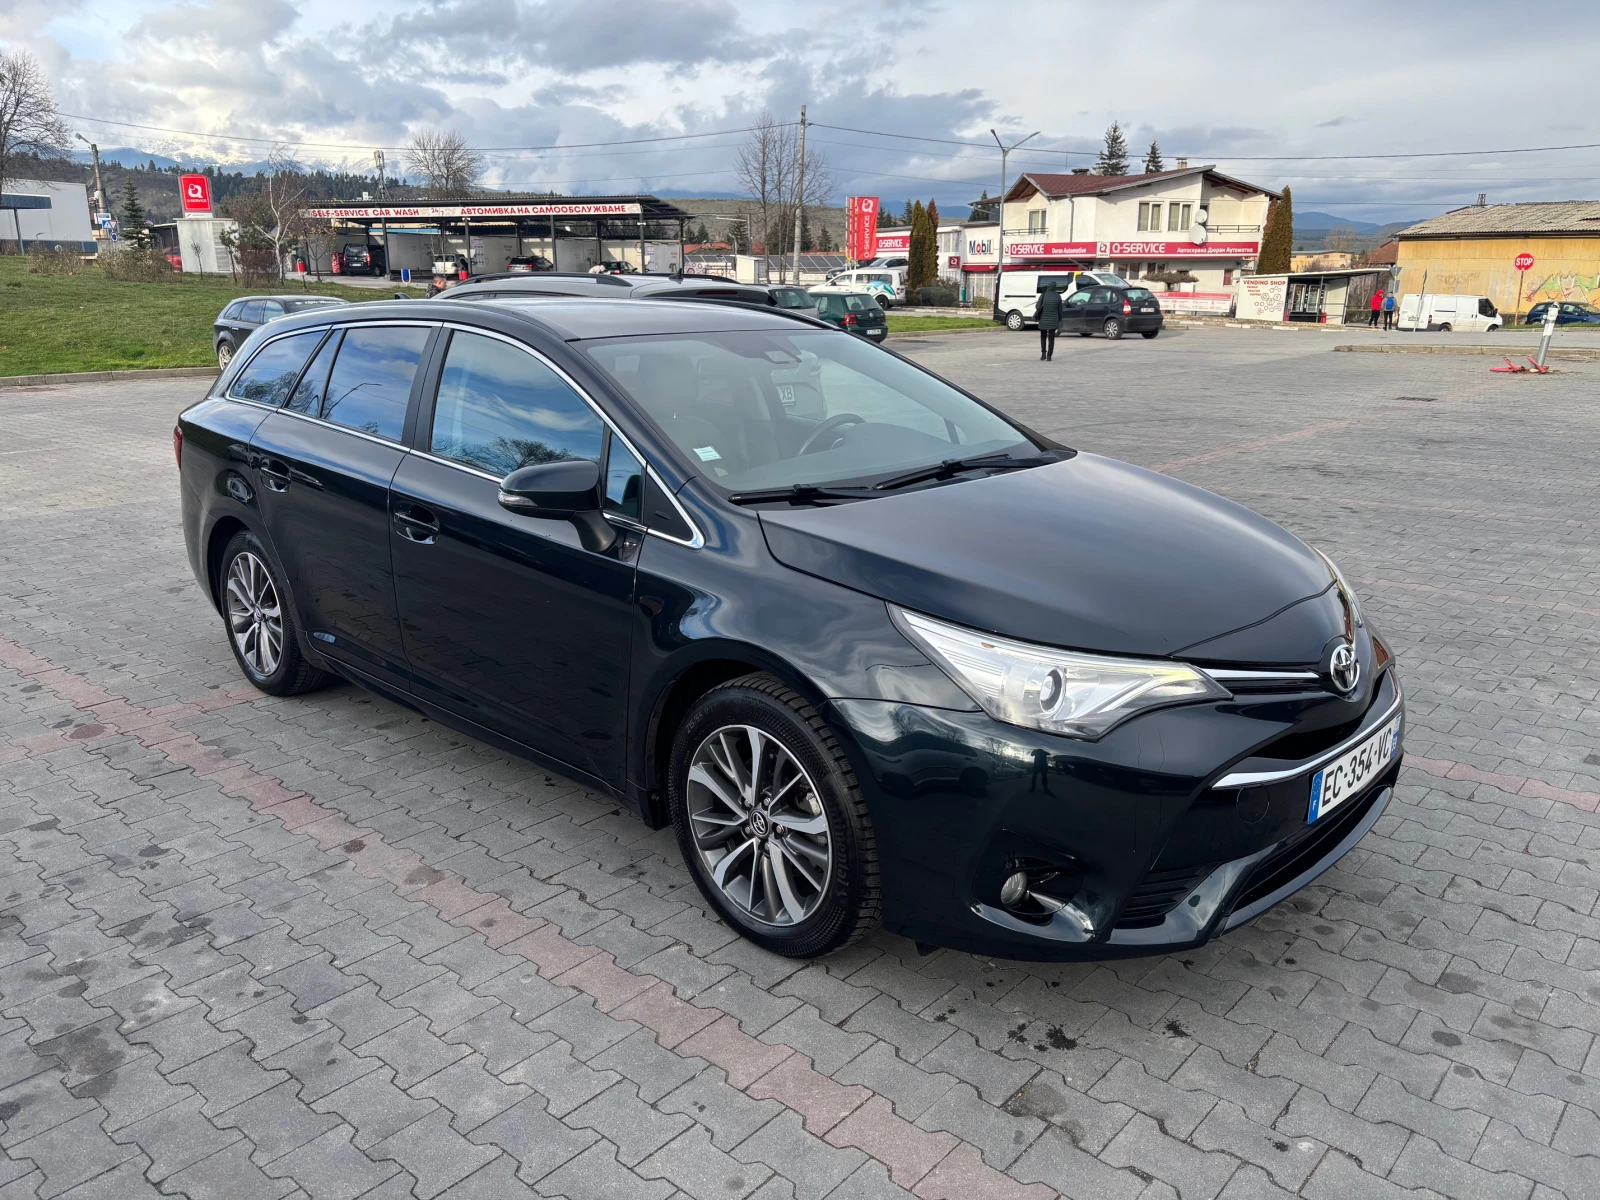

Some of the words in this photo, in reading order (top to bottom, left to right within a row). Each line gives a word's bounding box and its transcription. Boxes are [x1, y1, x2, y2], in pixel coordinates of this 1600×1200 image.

[312, 209, 370, 217] SELF-SERVICE
[372, 208, 391, 216] CAR
[393, 208, 420, 216] WASH
[461, 206, 516, 215] АВТОМИВКА
[517, 206, 531, 214] НА
[532, 204, 627, 214] САМООБСЛУЖВАНЕ
[878, 238, 903, 248] Q-SERVICE
[969, 239, 993, 255] Mobil
[1112, 242, 1166, 254] Q-SERVICE
[1011, 244, 1045, 254] Q-SERVICE
[1515, 257, 1533, 266] STOP
[780, 386, 793, 401] XB
[1322, 727, 1392, 808] EC-354-VC
[1311, 799, 1317, 811] F
